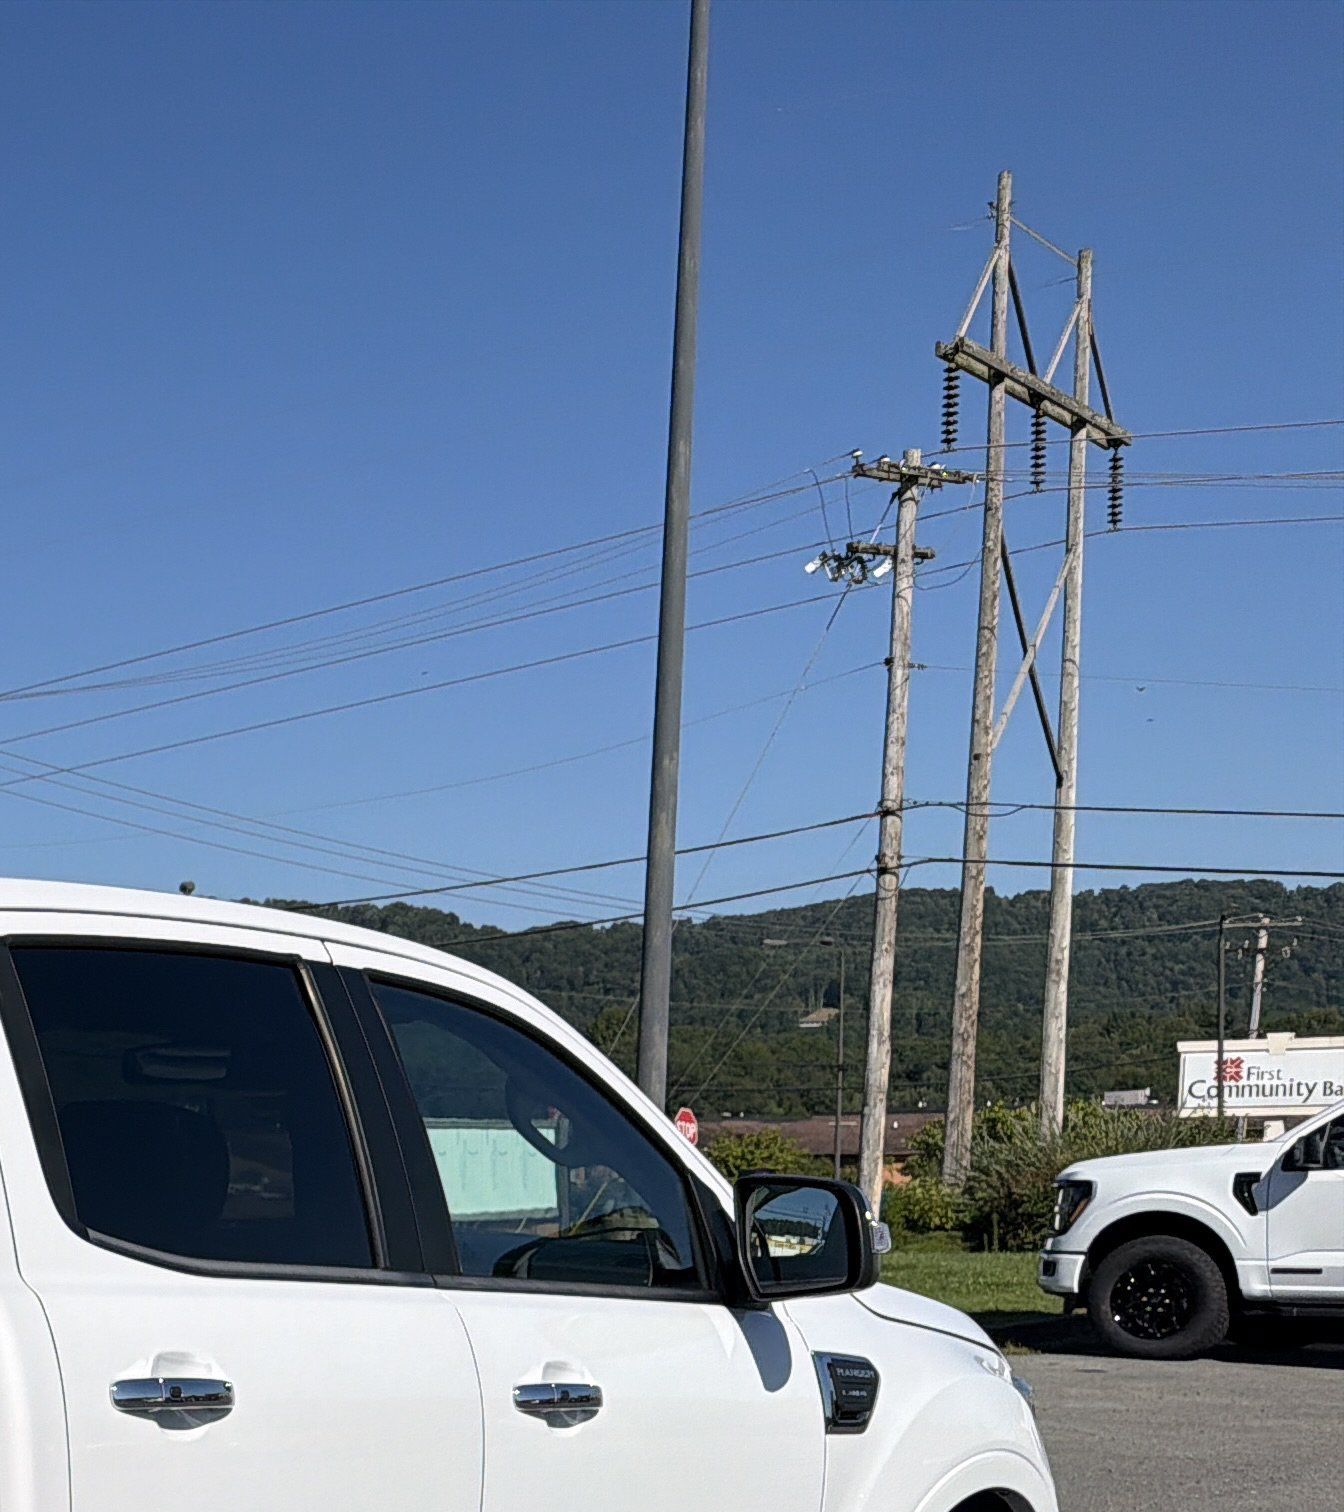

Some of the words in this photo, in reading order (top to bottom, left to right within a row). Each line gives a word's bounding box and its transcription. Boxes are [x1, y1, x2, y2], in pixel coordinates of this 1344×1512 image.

[1246, 1066, 1283, 1081] First
[1188, 1078, 1318, 1104] Community
[676, 1120, 696, 1141] STOP
